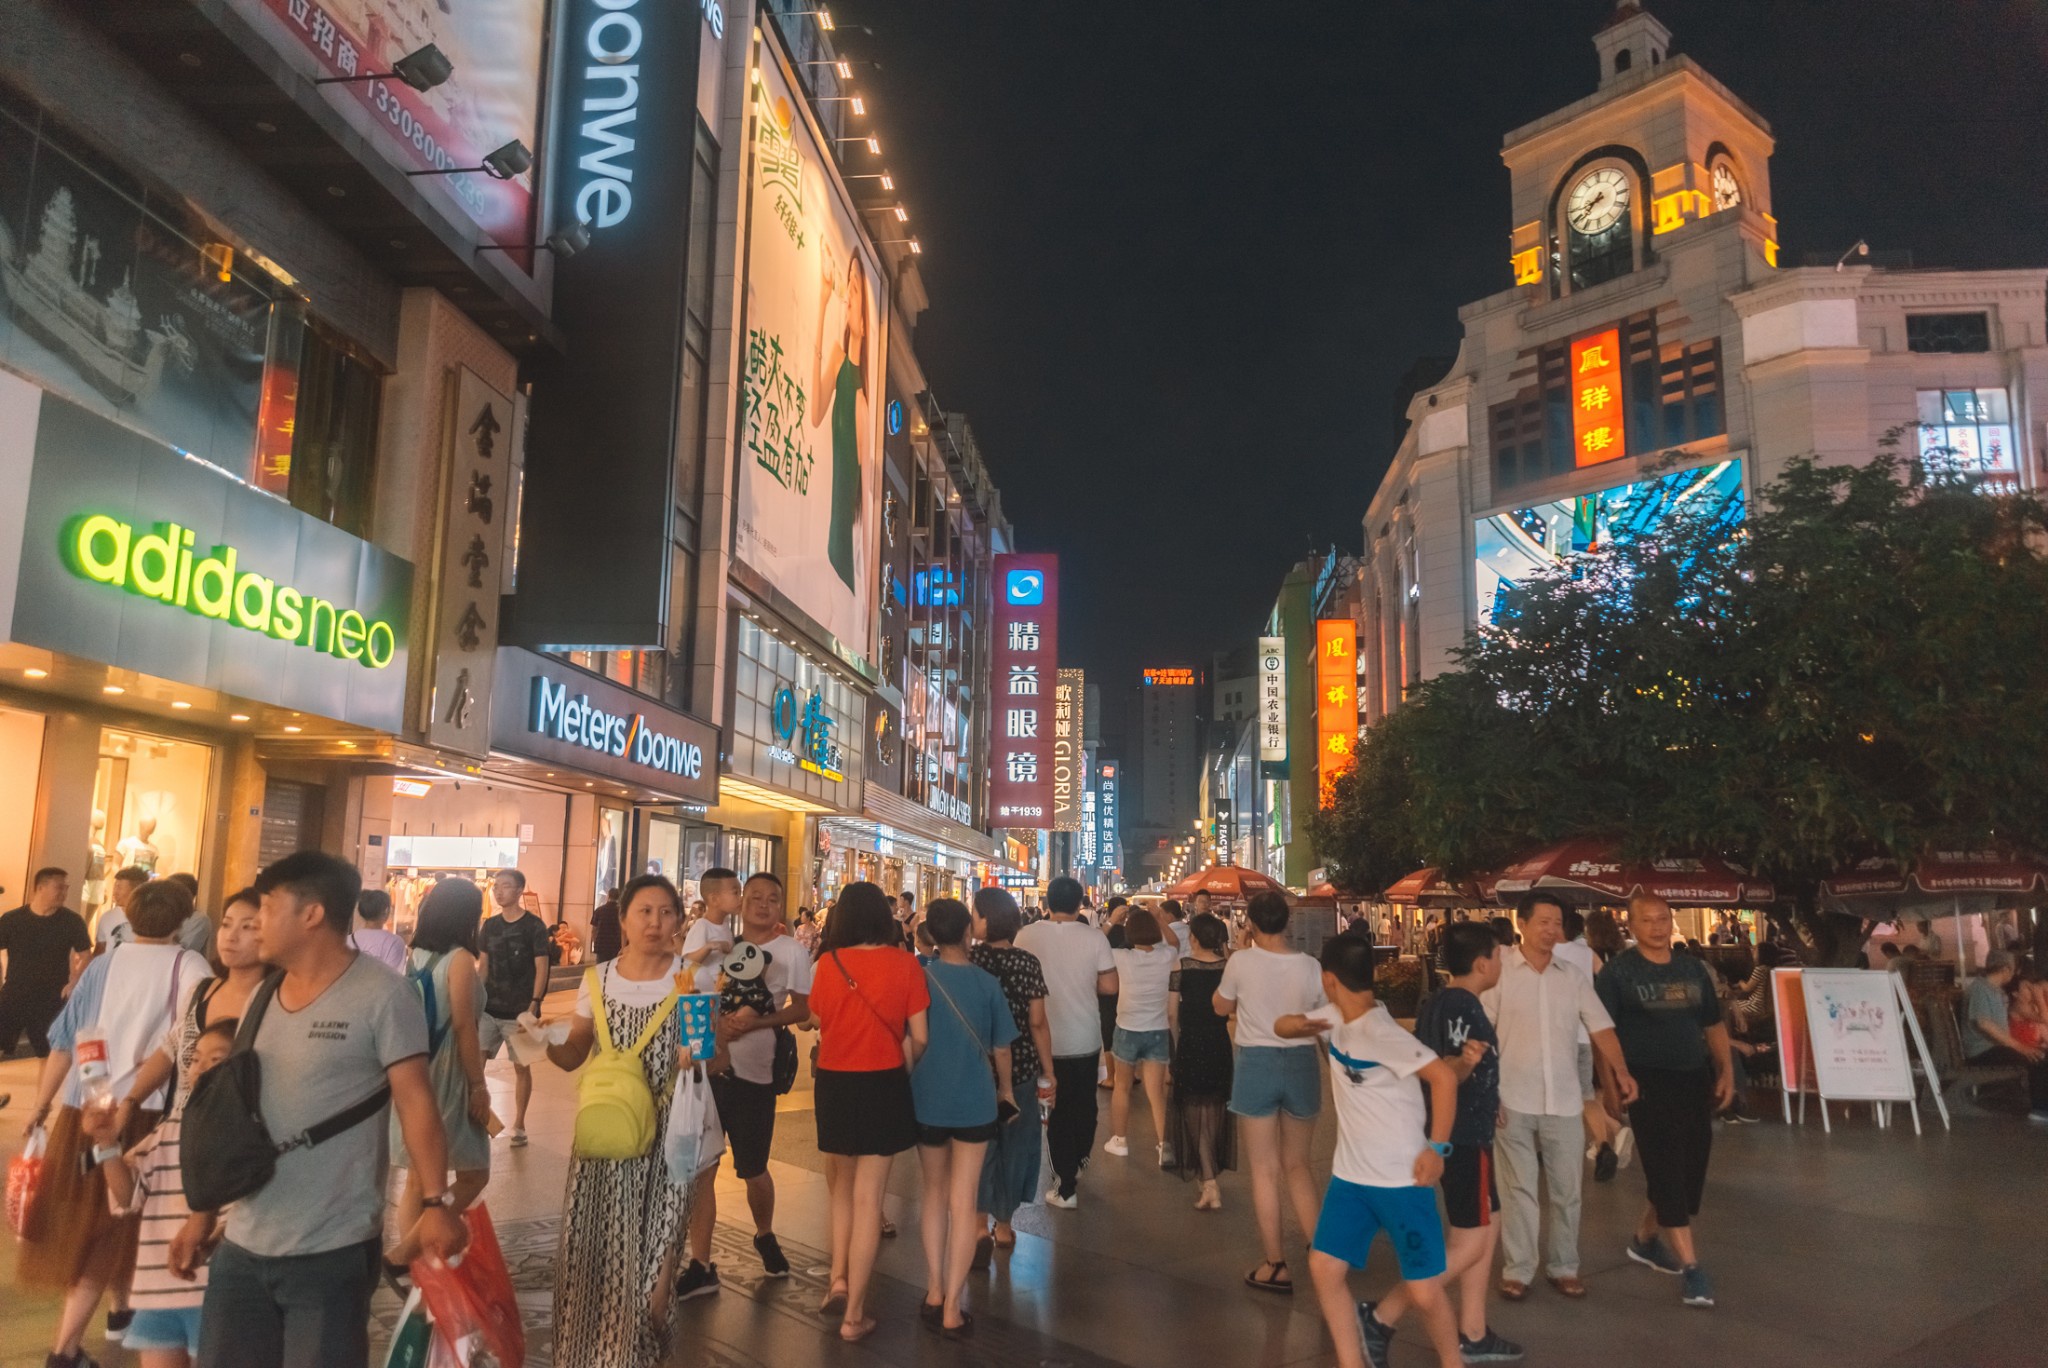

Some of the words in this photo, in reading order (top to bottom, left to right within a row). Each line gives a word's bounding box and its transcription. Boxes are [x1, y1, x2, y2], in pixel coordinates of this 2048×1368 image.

[576, 0, 643, 229] onwe
[1006, 621, 1040, 783] 精益眼镜
[1055, 685, 1072, 738] 歌莉娅
[1267, 673, 1280, 749] 中国农业银行
[1054, 740, 1072, 815] GLORIA
[1102, 779, 1114, 866] 尚客优精选酒店
